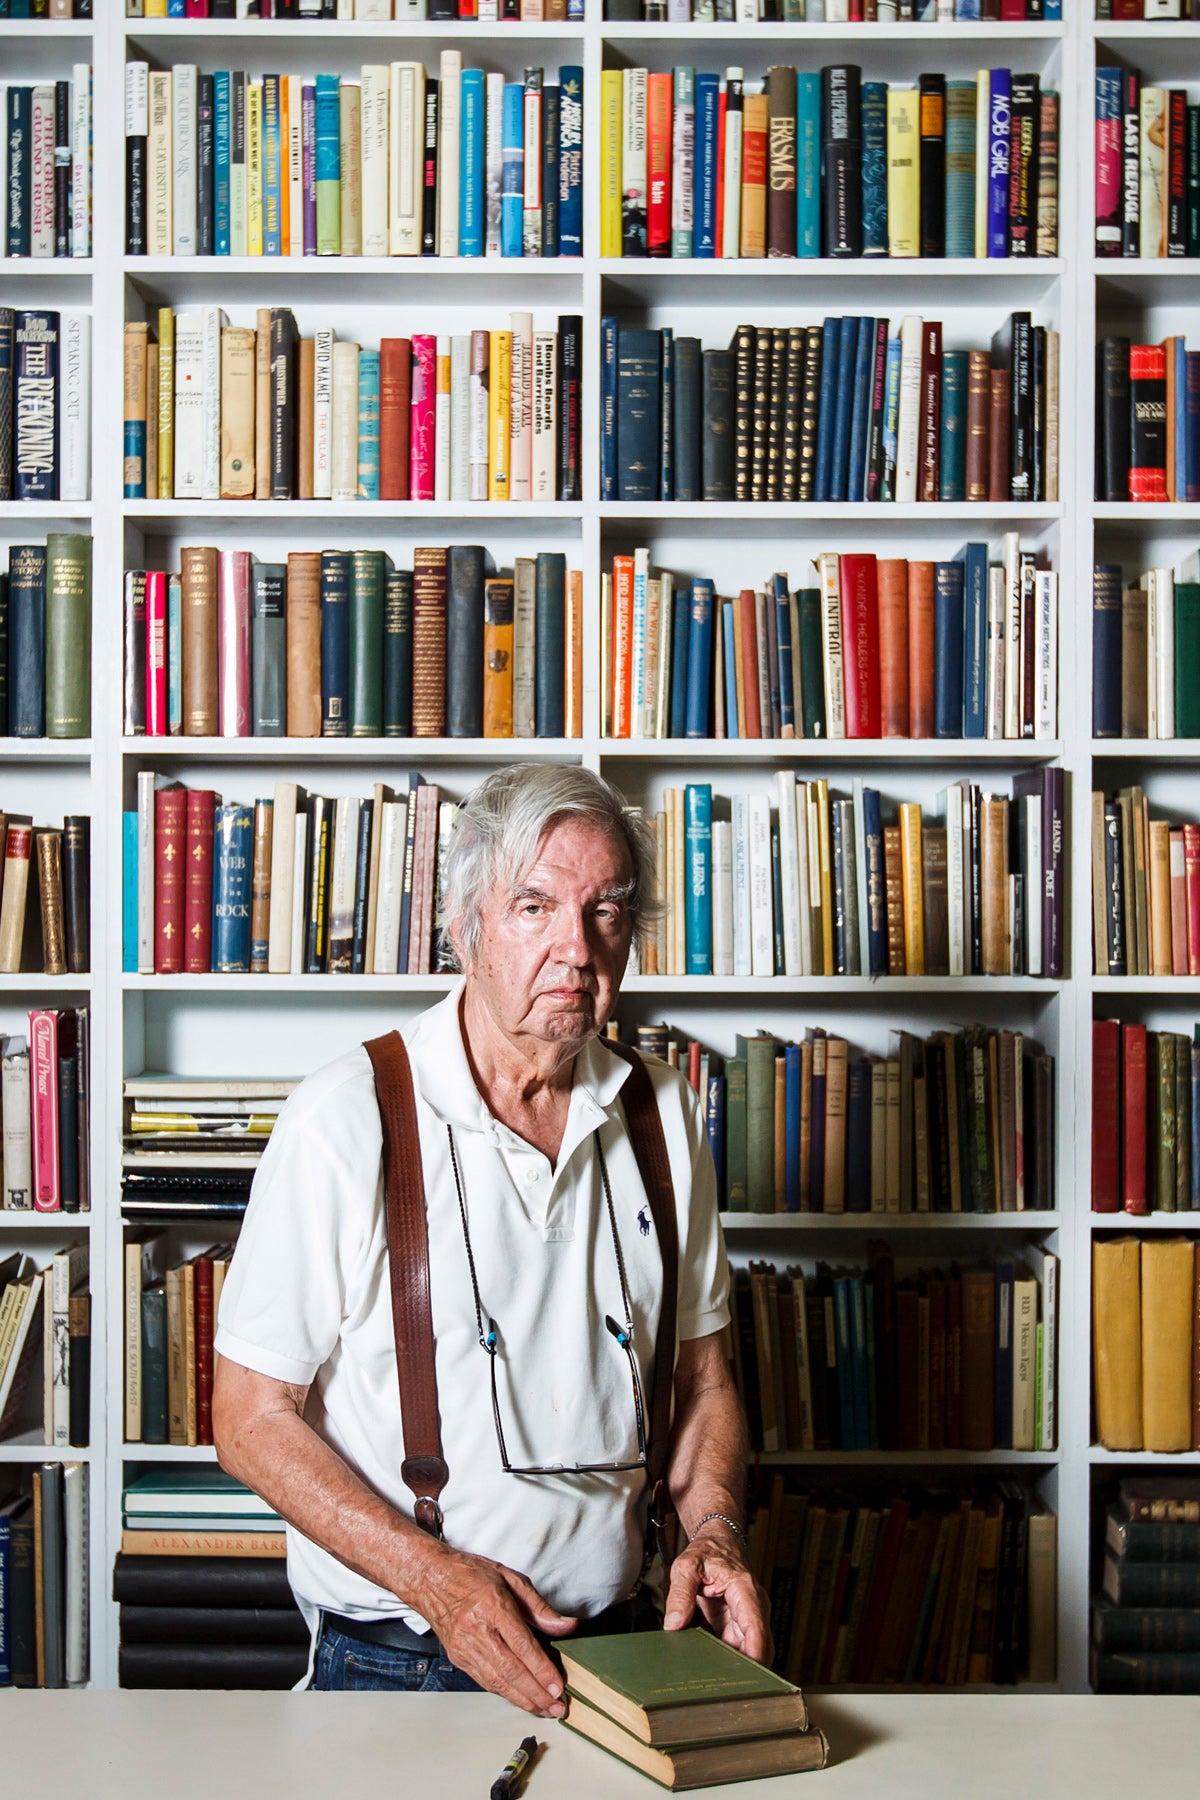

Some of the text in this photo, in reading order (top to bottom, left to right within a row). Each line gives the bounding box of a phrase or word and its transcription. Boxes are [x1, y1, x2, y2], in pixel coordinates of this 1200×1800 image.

[154, 105, 167, 126] Wilson
[266, 78, 276, 110] DESIGN
[636, 70, 644, 152] THE MEDICI GUNS
[830, 69, 848, 139] NEAL STEPHENSON
[1172, 94, 1184, 122] FREE
[176, 71, 189, 178] THE AUDUBON ARK
[203, 124, 212, 144] Black
[560, 96, 572, 148] AMERICA
[571, 102, 581, 144] HIGH IN
[705, 132, 712, 140] IN
[991, 94, 1010, 179] MOB GIRL
[1021, 116, 1032, 156] LEGEND
[1172, 124, 1184, 145] THE
[34, 106, 42, 235] GUANO RUSH
[45, 114, 54, 229] THE GREAT
[560, 150, 570, 201] Anderson
[570, 150, 580, 186] Patrick
[770, 116, 794, 191] ERASMUS
[1010, 116, 1021, 217] LEE HARVEY OSWALD
[1124, 114, 1138, 223] LAST REFUGE
[155, 148, 167, 242] DIVERSITY OF LIFE
[651, 180, 665, 204] Rubin
[837, 160, 846, 239] CRYPTONOMICON
[25, 344, 46, 376] THE
[68, 319, 80, 386] SPEAKING
[316, 332, 330, 404] DAVID MAMET
[68, 391, 80, 420] OUT
[159, 345, 172, 434] LEISERSON
[276, 354, 287, 406] CHRISTOPHER
[535, 344, 544, 436] and Barricades
[544, 344, 553, 430] Bombs Beards
[17, 376, 54, 474] RECKONING
[276, 407, 282, 417] OF
[924, 374, 936, 468] Semantics and the Body
[319, 412, 327, 470] THE VILLAGE
[11, 558, 44, 566] ISLAND
[13, 566, 42, 576] STORY
[20, 550, 34, 558] AN
[620, 572, 630, 596] HAND
[857, 622, 868, 668] HEALERS
[1042, 576, 1050, 669] WHY AMERICANS HATE POLITICS
[646, 600, 658, 706] The Way of Immortality
[1052, 819, 1061, 853] HAND
[220, 856, 246, 870] WEB
[692, 852, 704, 896] BURNS
[736, 838, 744, 888] ARGUMENT
[952, 824, 961, 902] EDWARD LEAR
[1046, 869, 1054, 899] POET
[216, 904, 248, 918] ROCK
[37, 1022, 50, 1096] Marcel Proust
[151, 1538, 245, 1550] ALEXANDER
